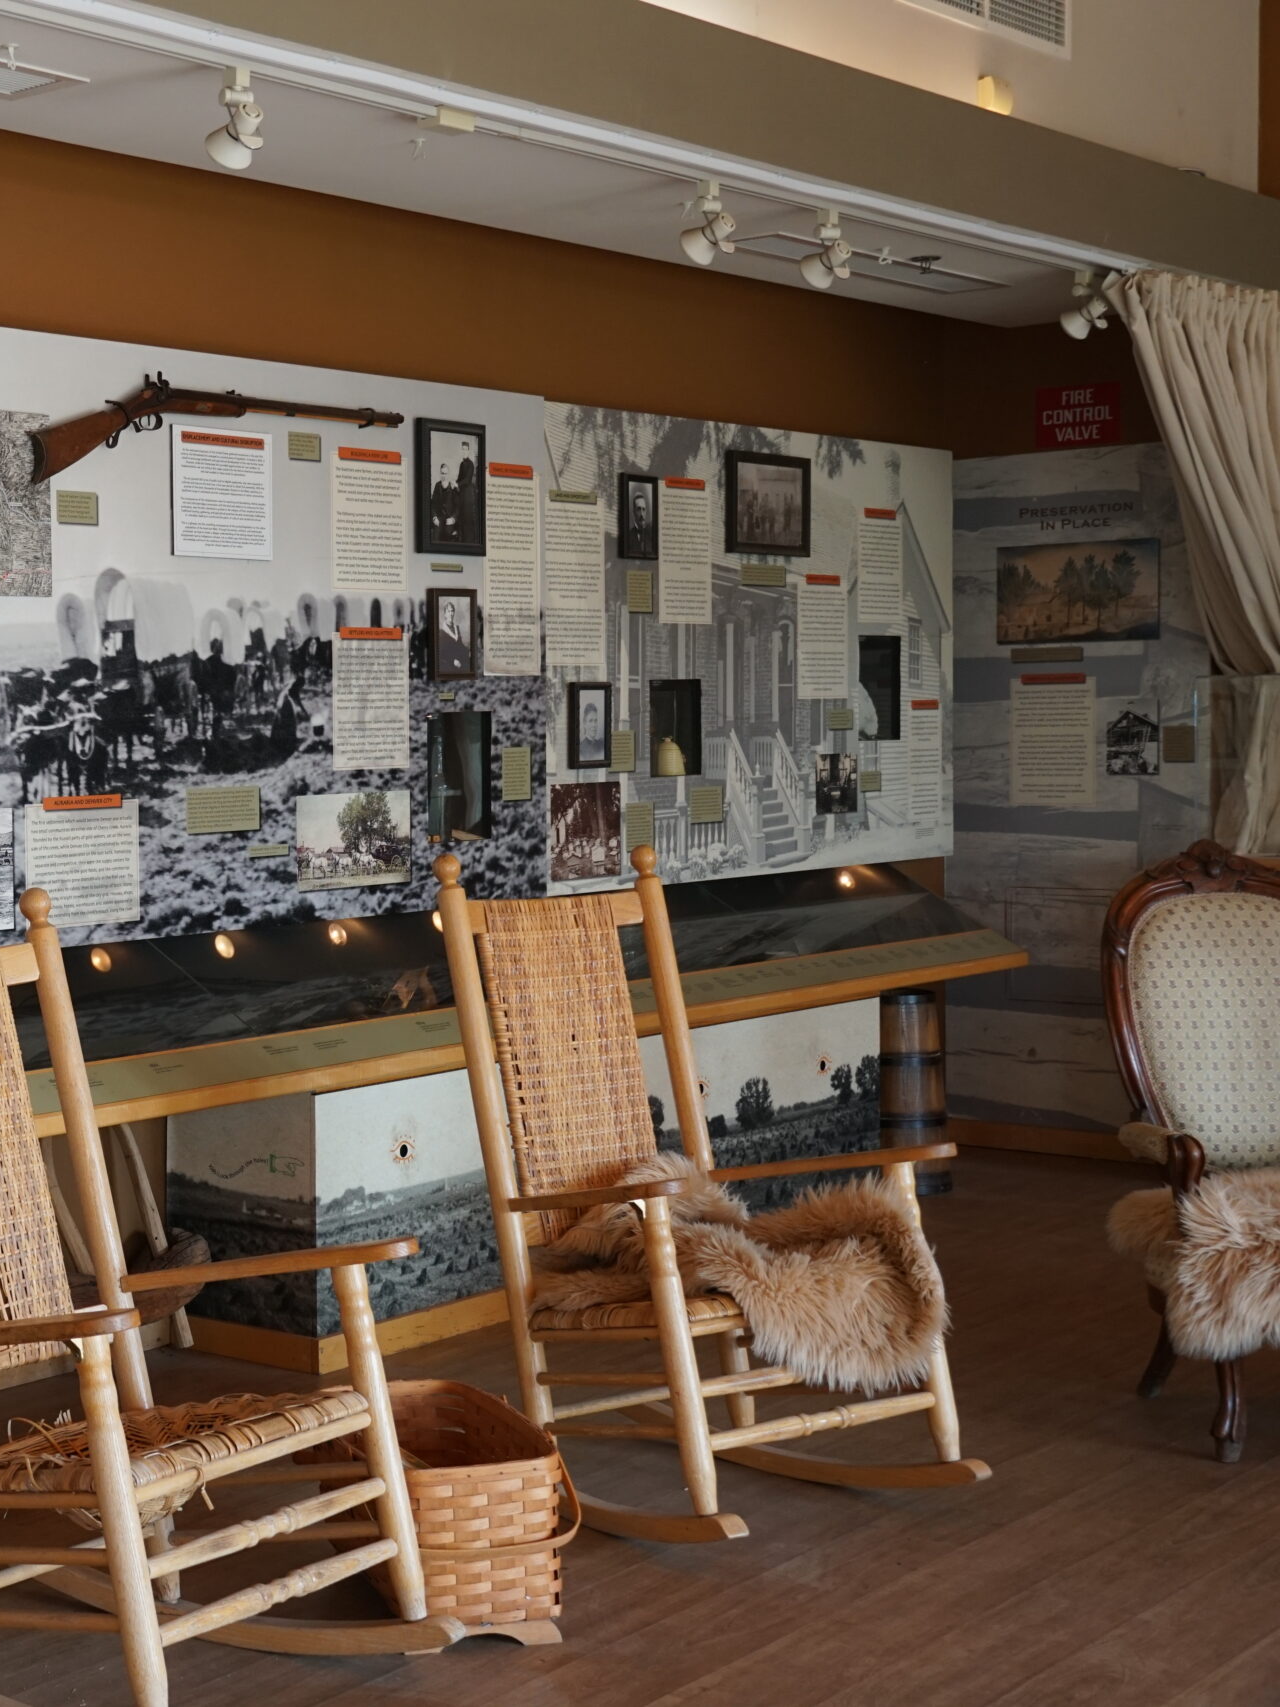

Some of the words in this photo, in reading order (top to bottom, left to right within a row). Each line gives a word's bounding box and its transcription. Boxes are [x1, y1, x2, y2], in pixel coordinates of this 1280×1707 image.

[1061, 389, 1094, 405] FIRE
[1043, 405, 1112, 425] CONTROL
[1055, 424, 1100, 442] VALVE
[1019, 502, 1134, 518] PRESERVATION
[1040, 520, 1055, 531] IN
[1061, 518, 1111, 529] PLACE
